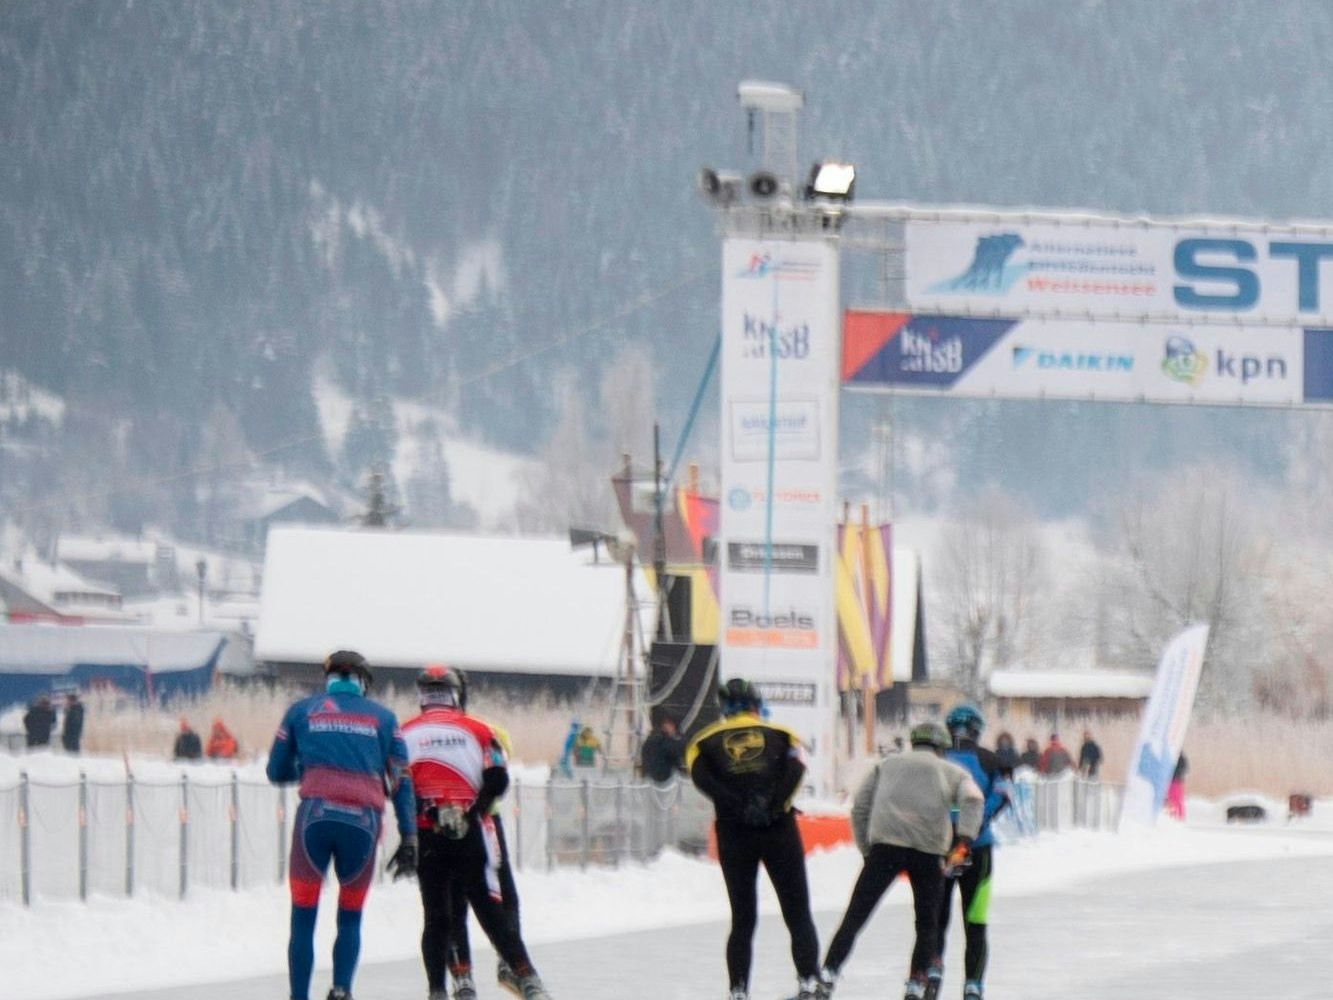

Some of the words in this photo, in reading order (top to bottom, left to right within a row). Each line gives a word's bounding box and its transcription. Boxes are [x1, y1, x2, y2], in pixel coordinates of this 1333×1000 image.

[1027, 278, 1157, 297] Weissensee
[1037, 353, 1134, 371] DAIKIN
[1217, 346, 1287, 382] kpn
[730, 609, 815, 630] Boels
